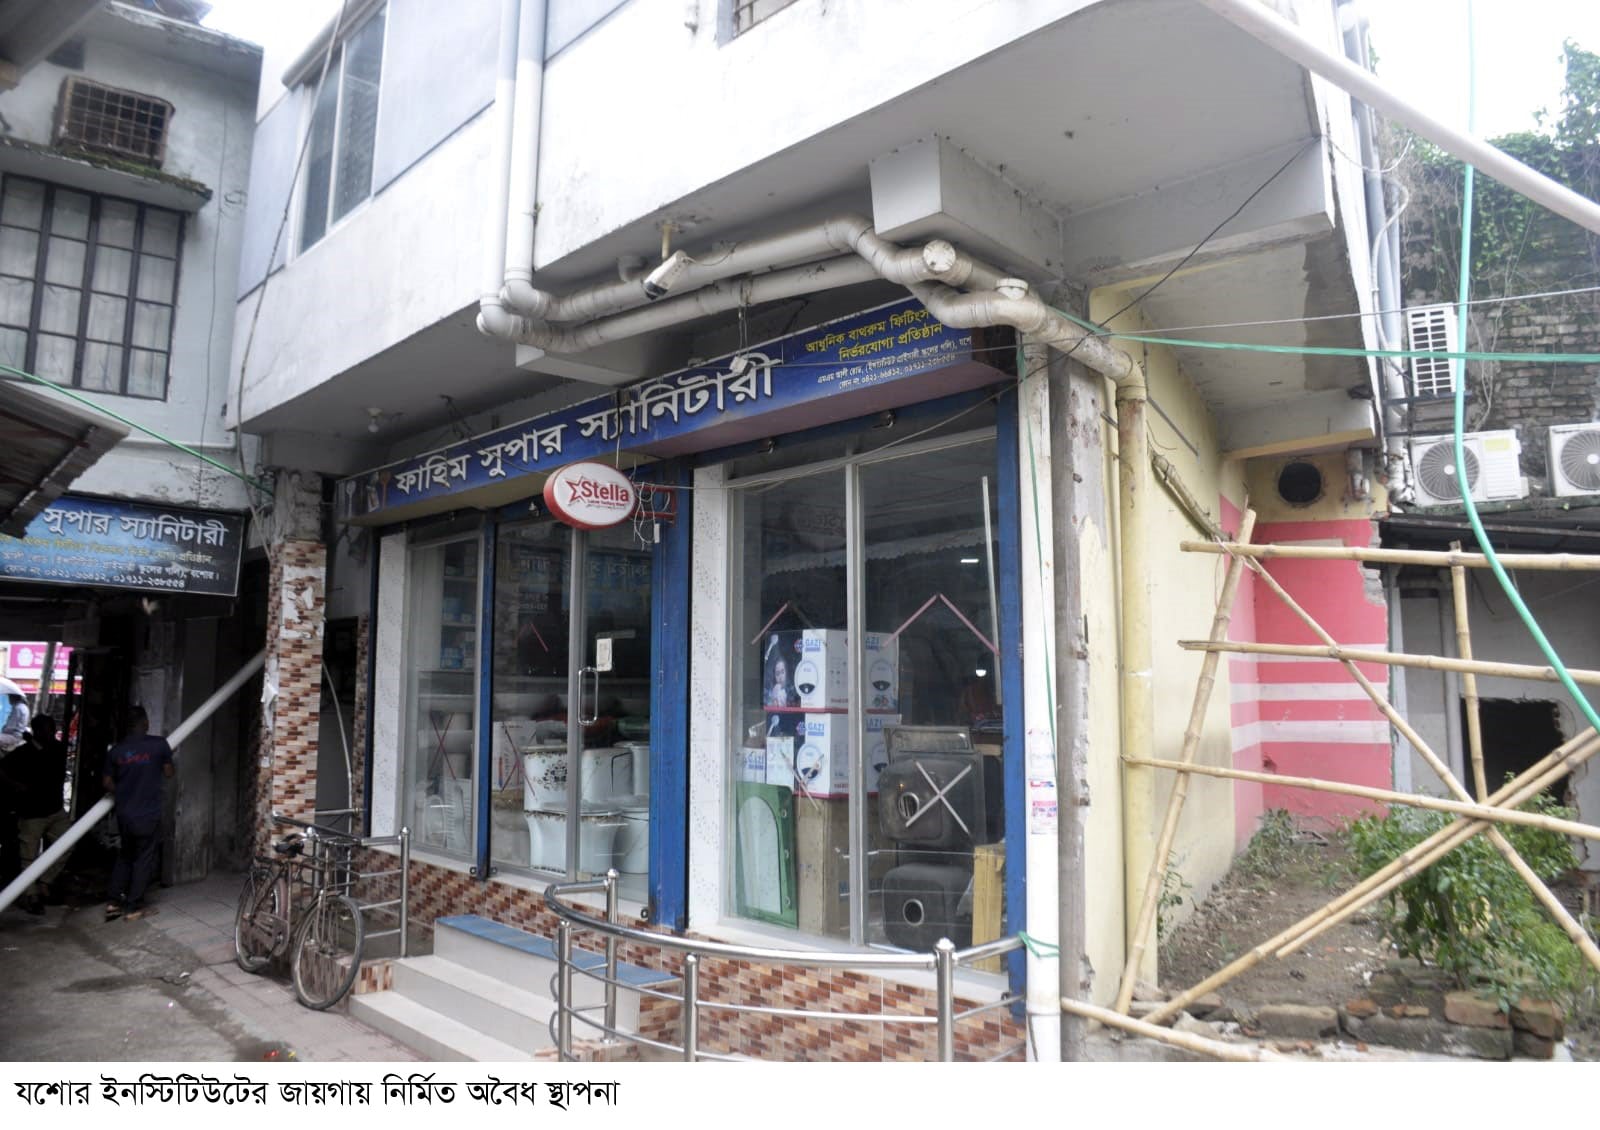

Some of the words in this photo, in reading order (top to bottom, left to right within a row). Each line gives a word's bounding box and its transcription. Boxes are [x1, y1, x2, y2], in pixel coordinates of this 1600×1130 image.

[805, 331, 846, 353] আধুনিক
[848, 320, 887, 342] বাথরুম
[838, 334, 895, 363] নির্ভরযোগ্য
[897, 321, 944, 345] প্রতিষ্ঠান
[395, 453, 472, 497] ফাহিম
[477, 423, 570, 478] সুপার
[576, 352, 785, 441] স্যানিটারী
[580, 480, 629, 502] Stella
[43, 506, 114, 536] সুপার
[119, 513, 230, 547] স্যানিটারী
[805, 639, 821, 648] GAZI
[808, 722, 825, 732] GAZI
